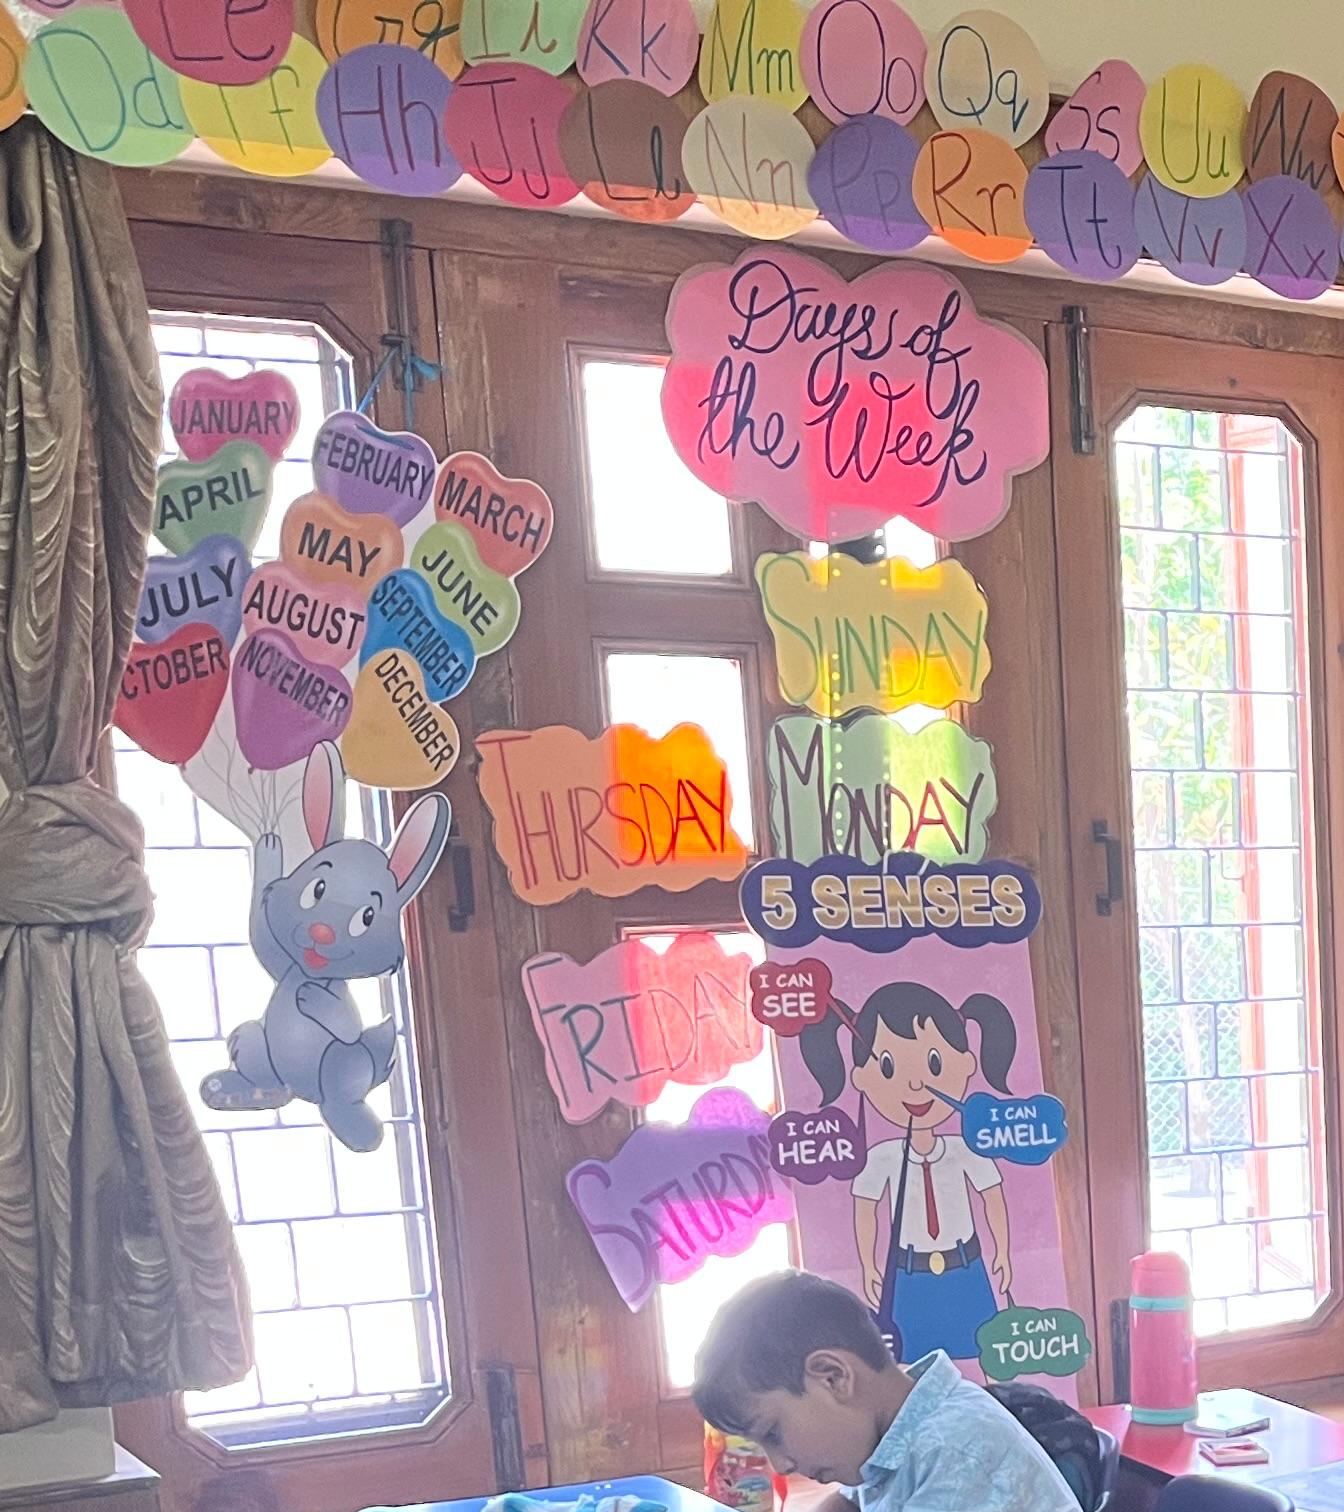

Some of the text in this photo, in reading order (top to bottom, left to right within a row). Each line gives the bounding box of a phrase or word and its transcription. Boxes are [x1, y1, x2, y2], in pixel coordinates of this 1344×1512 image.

[35, 28, 184, 152] Dd
[708, 0, 794, 94] Mm
[817, 0, 918, 116] Oo
[938, 25, 1029, 132] Qq
[335, 63, 440, 174] Hh
[458, 77, 550, 199] Jj
[704, 112, 798, 214] Nn
[1162, 78, 1229, 183] Uu
[831, 122, 901, 237] Pp
[930, 132, 1016, 236] Rr
[1038, 165, 1122, 269] Tt
[1248, 192, 1328, 280] Xx
[728, 259, 972, 419] Days of
[174, 399, 294, 435] JANUARY
[698, 356, 987, 507] the Week
[157, 467, 265, 530] APRIL
[317, 429, 434, 500] FEBRUARY
[298, 522, 381, 577] MAY
[438, 471, 545, 554] MARCH
[140, 559, 237, 627] JULY
[244, 580, 365, 651] AUGUST
[373, 574, 467, 696] SEPTEMBER
[422, 550, 498, 637] JUNE
[762, 555, 984, 704] SUNDAY
[121, 637, 228, 700] CTOBER
[240, 641, 349, 727] NOVEMBER
[375, 652, 455, 771] DECEMBER
[475, 735, 727, 889] THURSDAY
[775, 724, 985, 858] MONDAY
[761, 874, 1027, 930] 5 SENSES
[759, 973, 813, 988] I CAN
[763, 992, 816, 1018] SEE
[526, 957, 751, 1107] FRIDAY
[778, 1139, 855, 1165] HEAR
[786, 1119, 840, 1135] I CAN
[976, 1123, 1056, 1149] SMELL
[990, 1105, 1037, 1122] I CAN
[569, 1134, 775, 1302] SATURDA
[992, 1333, 1079, 1363] TOUCH
[1011, 1317, 1057, 1336] I CAN
